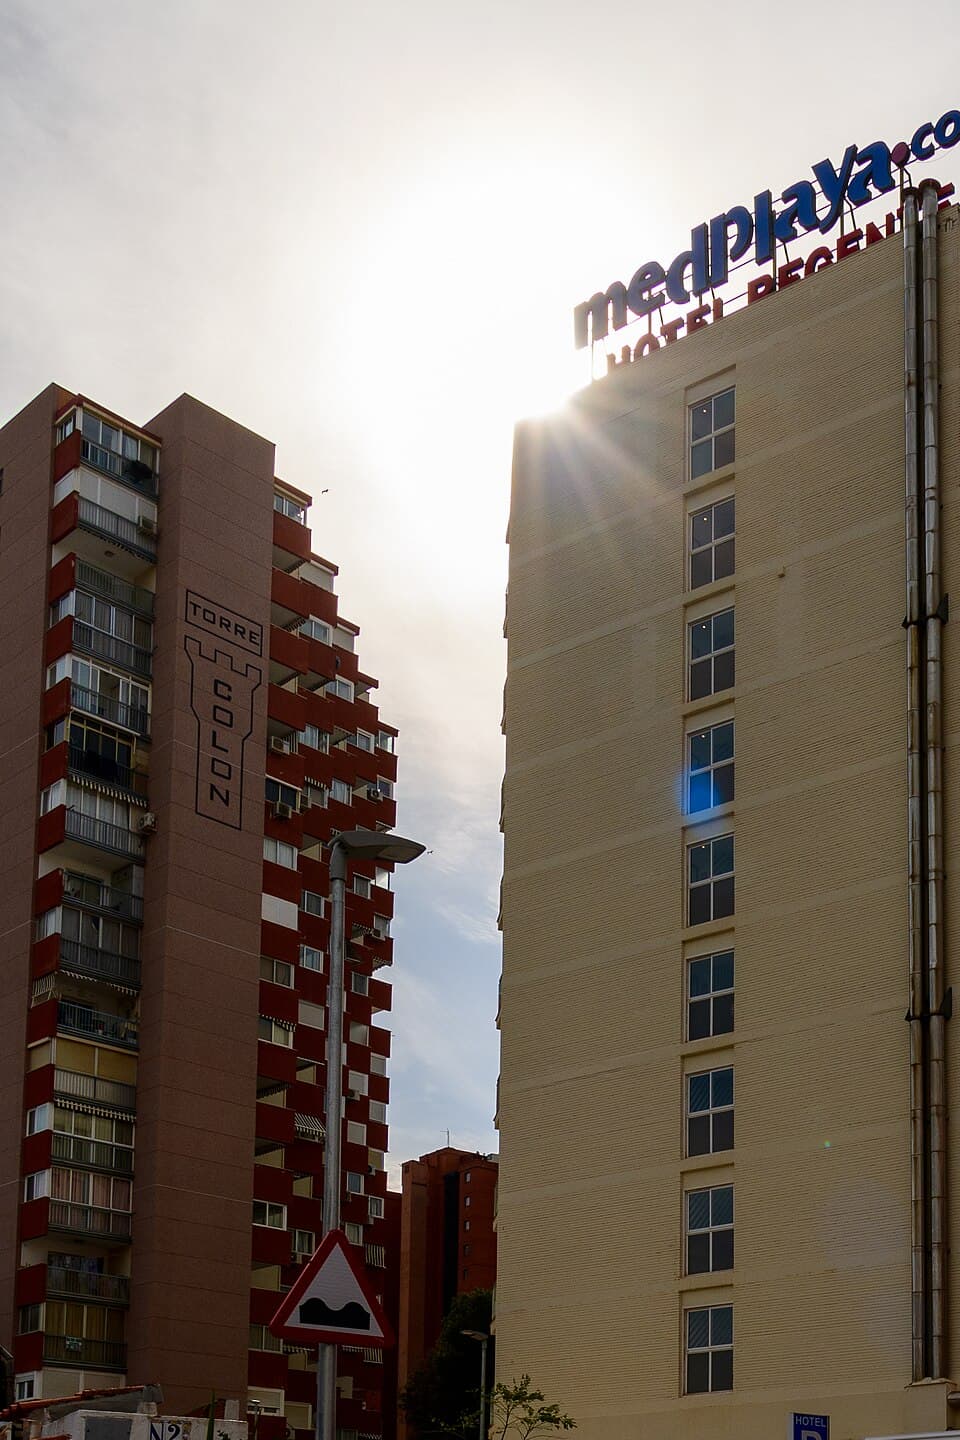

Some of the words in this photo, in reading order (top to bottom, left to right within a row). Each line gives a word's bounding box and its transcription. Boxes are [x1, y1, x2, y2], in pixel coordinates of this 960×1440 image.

[747, 182, 955, 304] REGEN
[189, 601, 261, 647] TORRE
[209, 678, 234, 808] COLON
[795, 1415, 827, 1428] HOTEL
